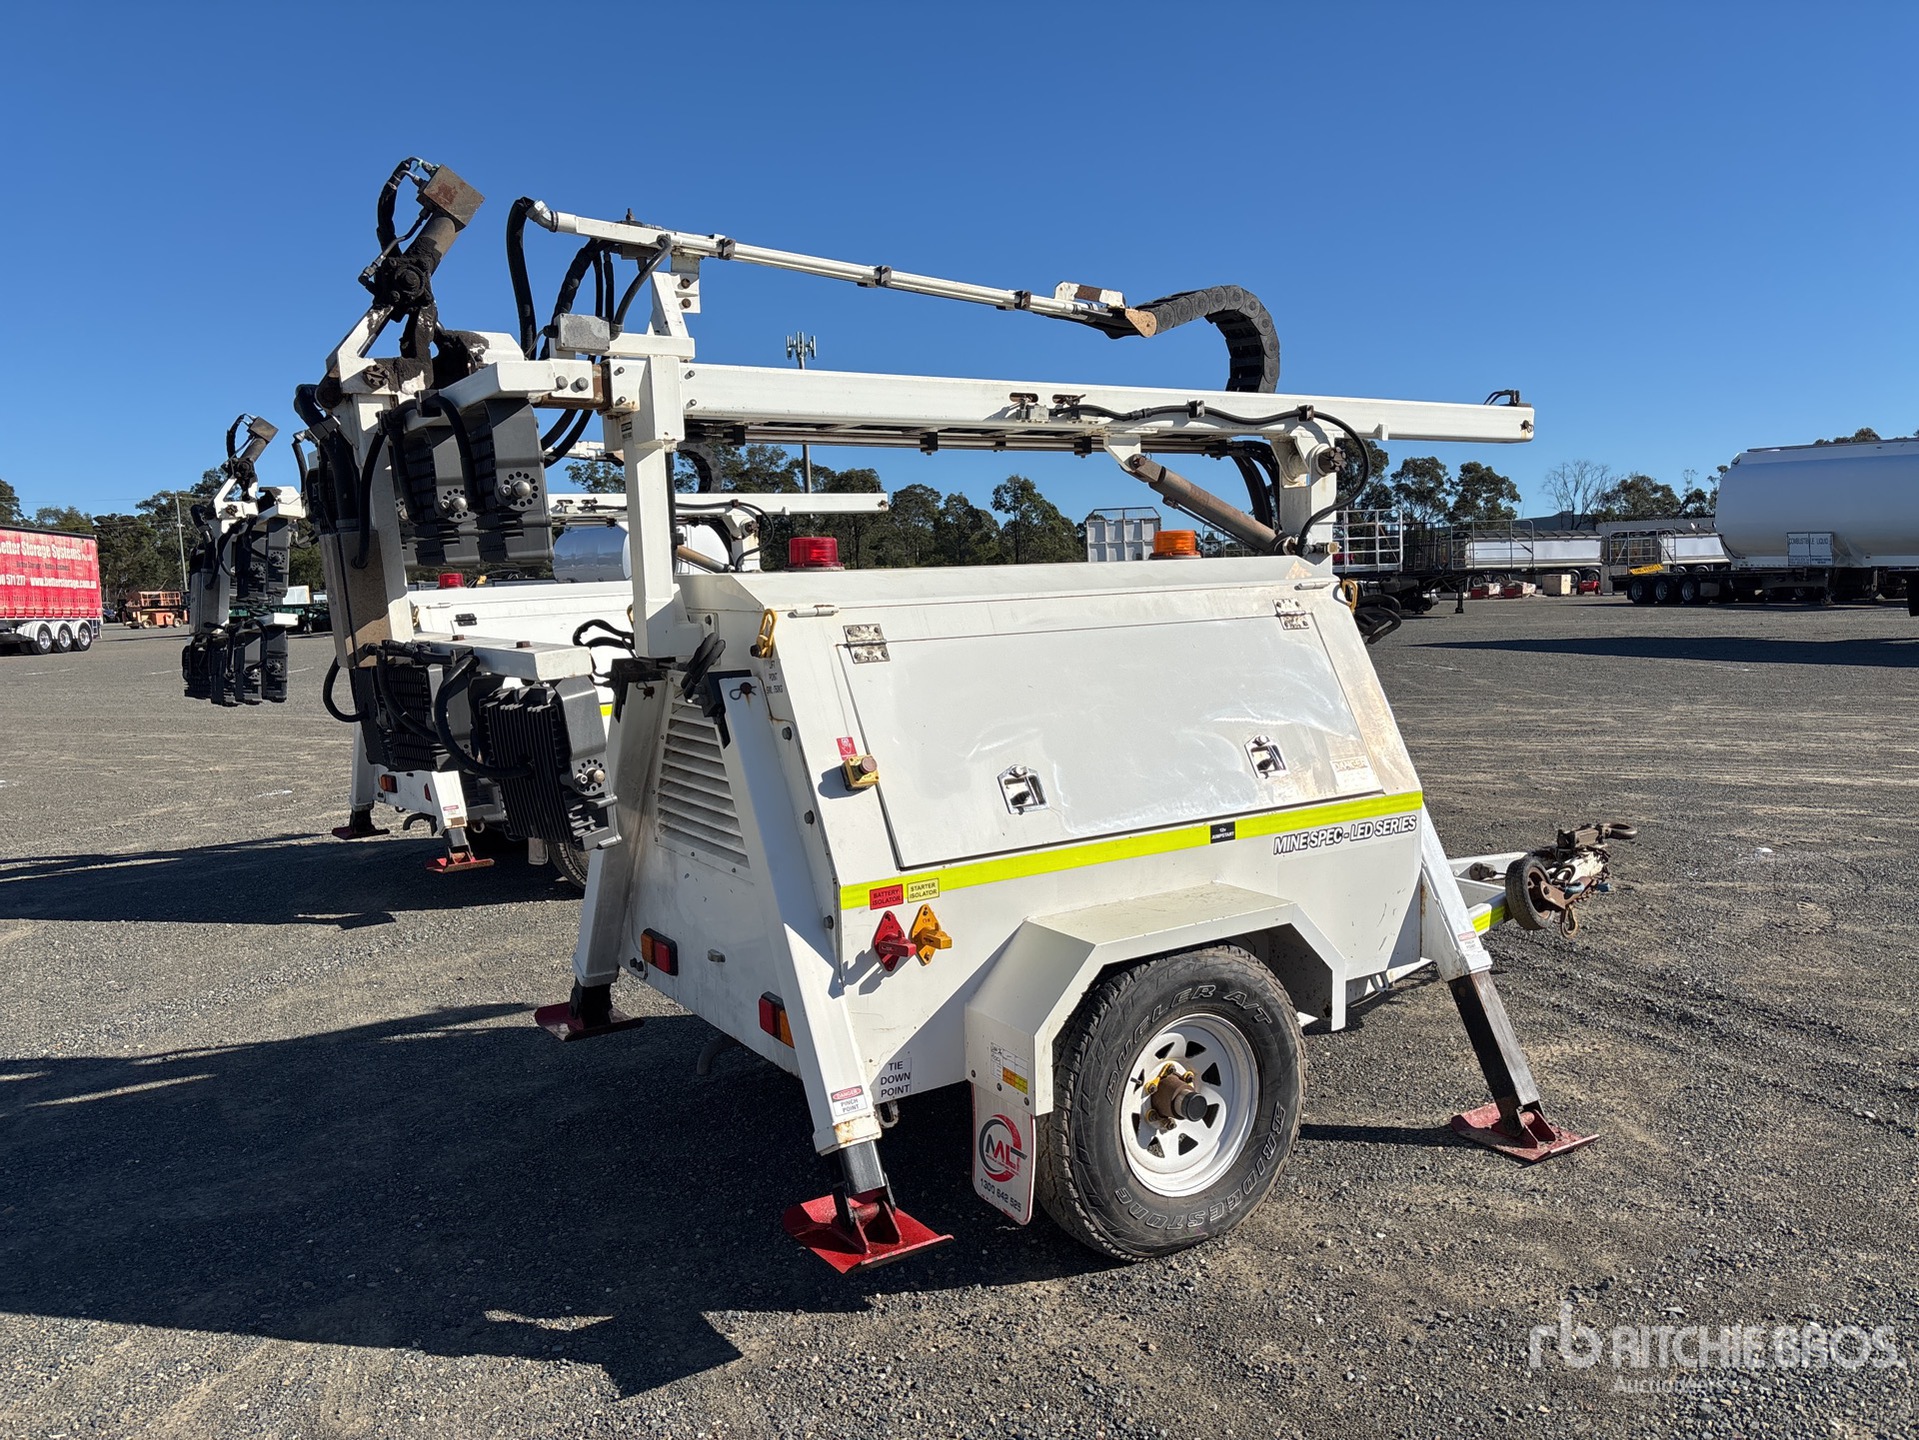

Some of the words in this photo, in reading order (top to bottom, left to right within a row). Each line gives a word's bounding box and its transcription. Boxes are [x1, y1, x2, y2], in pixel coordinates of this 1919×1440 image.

[21, 541, 51, 559] Storage
[51, 543, 81, 560] Systems
[1273, 832, 1309, 855] MINE
[1309, 827, 1343, 848] SPEC
[1350, 821, 1373, 841] LED
[1374, 815, 1417, 837] SERIES
[910, 882, 936, 892] STARTER
[873, 889, 899, 899] BATTERY
[910, 889, 937, 899] ISOLATOR
[873, 896, 901, 906] ISOLATOR
[1105, 984, 1217, 1106] DUELER
[1223, 990, 1273, 1026] A/T
[889, 1061, 904, 1071] TIE
[880, 1072, 912, 1086] DOWN
[881, 1084, 911, 1098] POINT
[840, 1098, 859, 1108] PINCH
[842, 1104, 860, 1113] POINT
[1115, 1100, 1286, 1230] BRIDGESTONE
